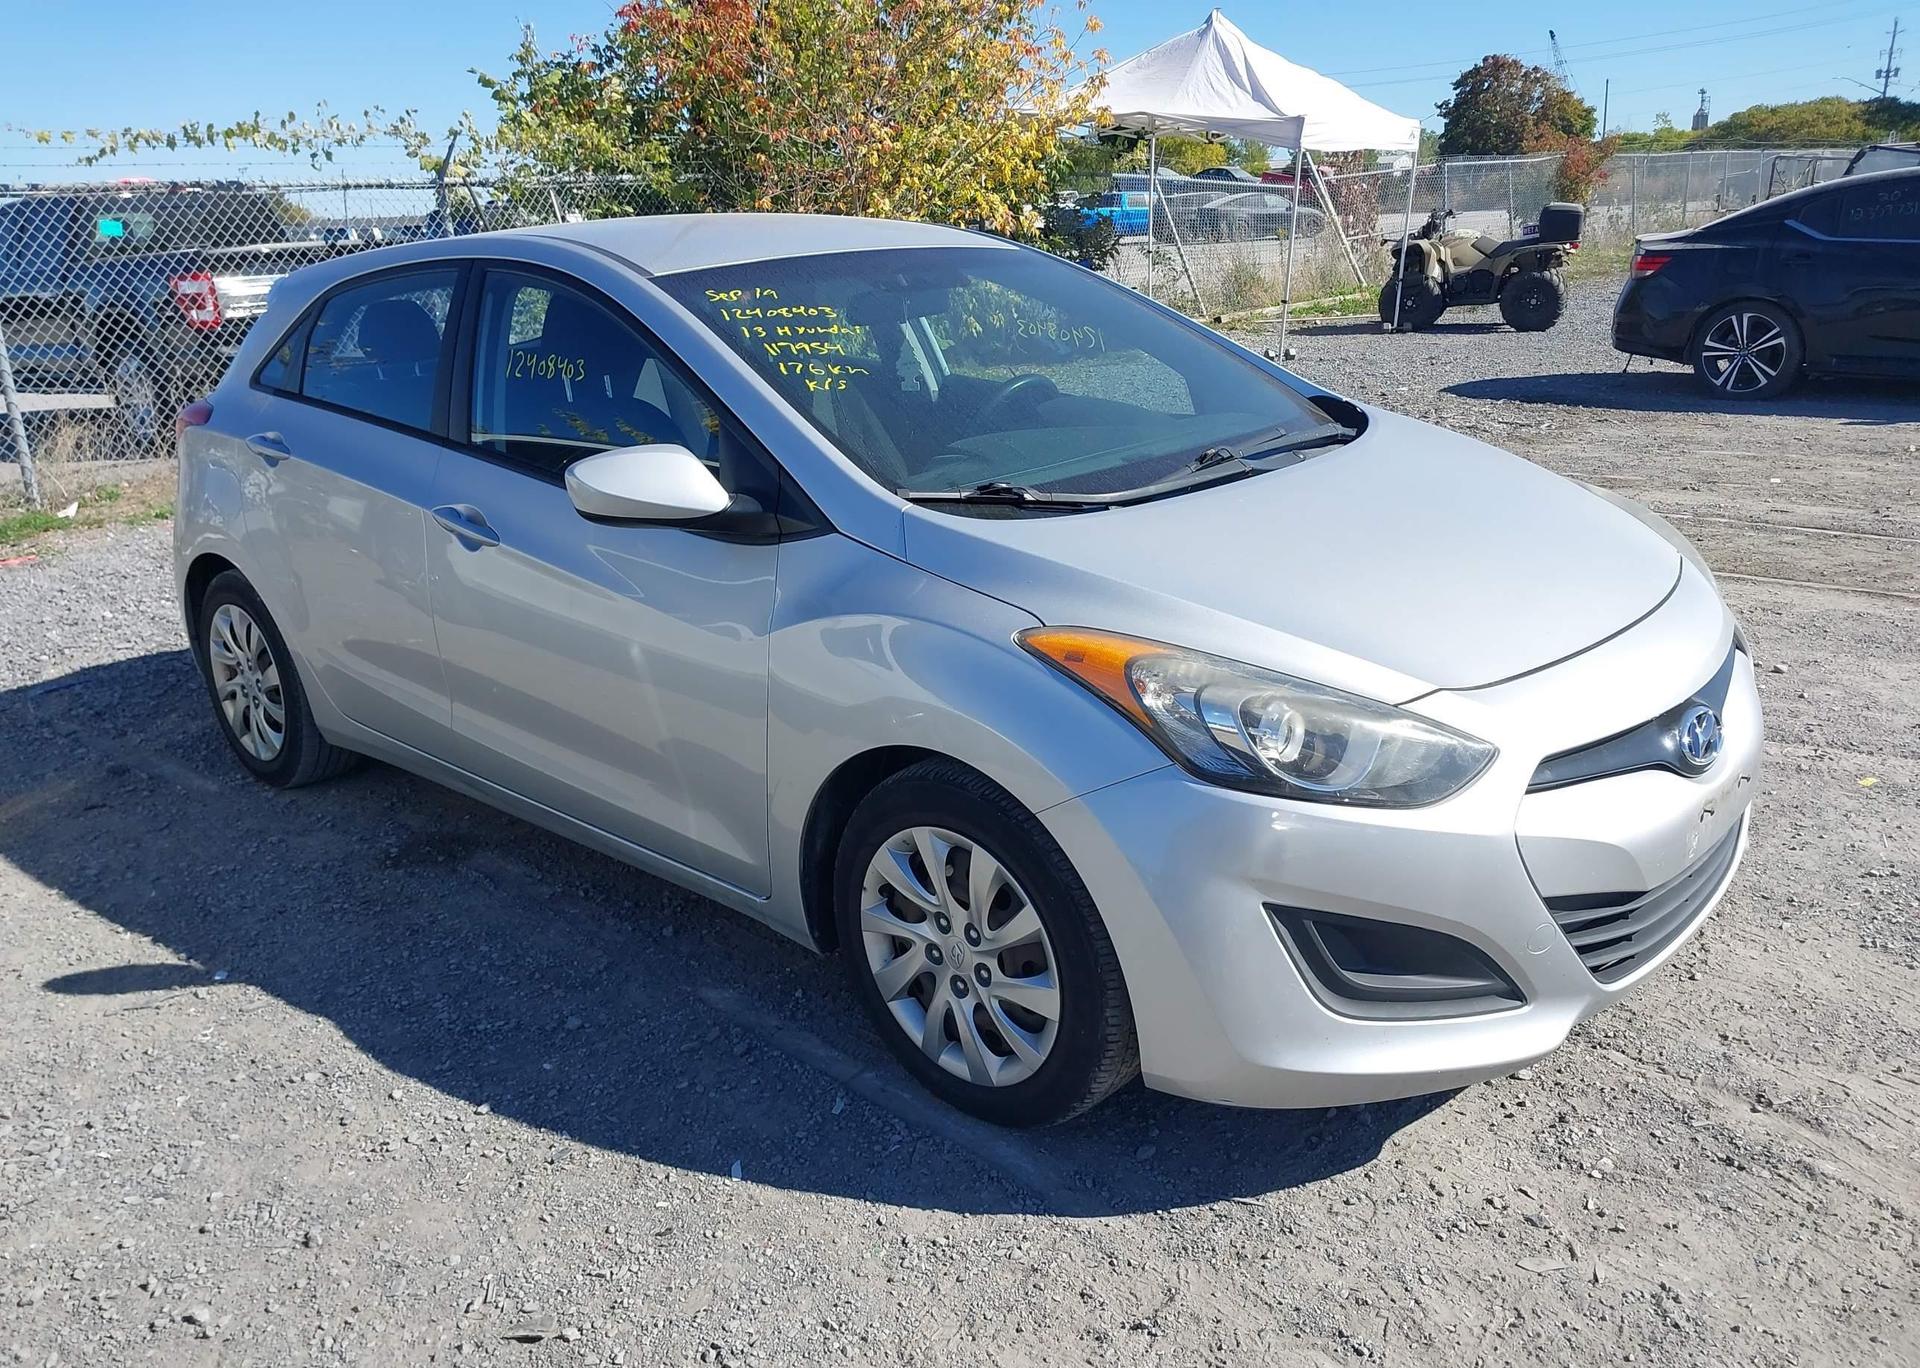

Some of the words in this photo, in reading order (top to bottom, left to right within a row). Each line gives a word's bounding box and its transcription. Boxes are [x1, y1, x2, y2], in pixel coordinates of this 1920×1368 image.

[720, 306, 837, 321] 12408403
[741, 326, 767, 338] 13
[506, 348, 585, 381] 12408403
